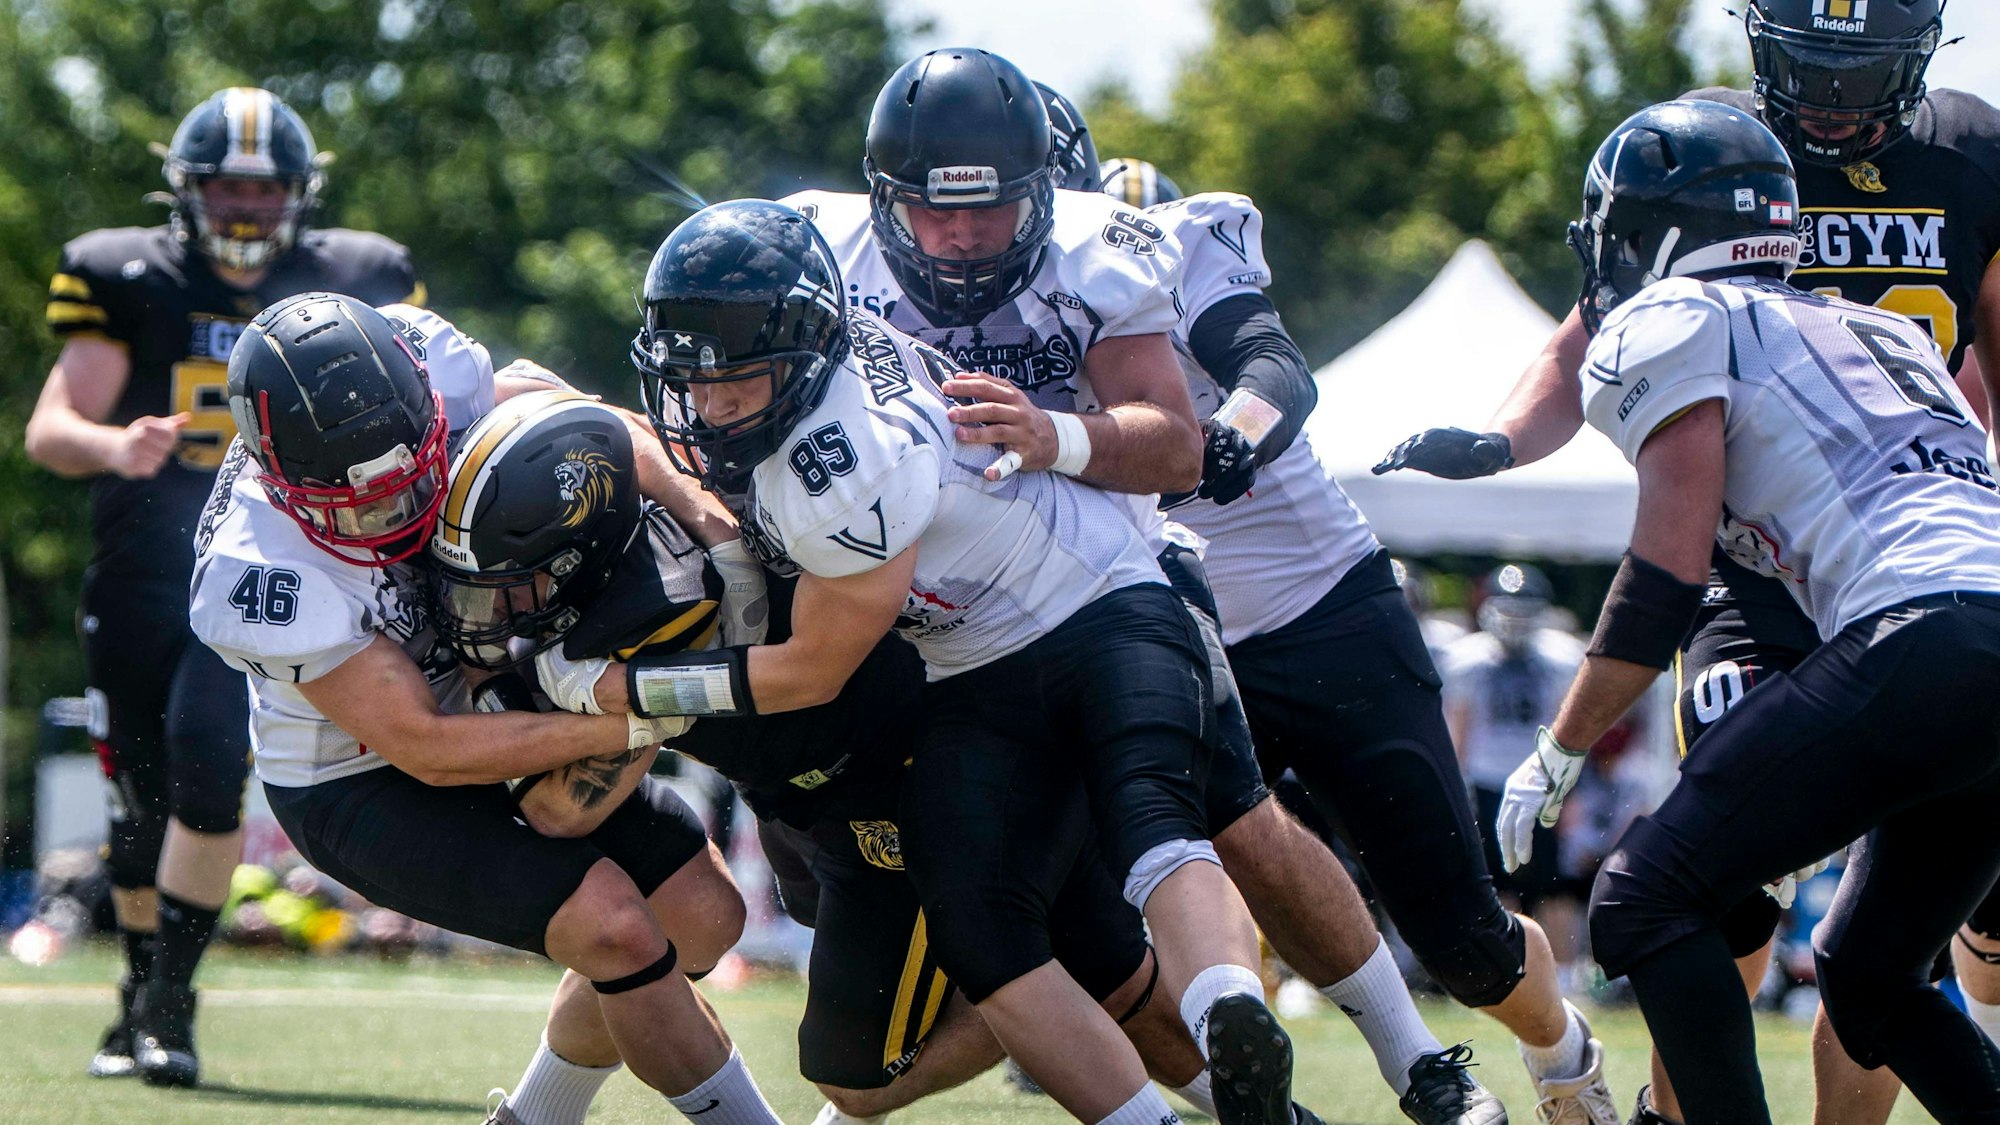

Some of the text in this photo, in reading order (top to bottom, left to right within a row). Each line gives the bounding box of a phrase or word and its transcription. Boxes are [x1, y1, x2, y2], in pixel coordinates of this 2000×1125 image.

[1813, 16, 1865, 33] Riddell
[943, 170, 983, 182] Riddell
[1738, 200, 1752, 208] GFL
[1102, 209, 1167, 257] 36
[1732, 240, 1798, 261] Riddell
[1818, 214, 1946, 268] GYM
[1838, 314, 1970, 428] 6
[788, 421, 859, 496] 85
[434, 538, 467, 562] Riddell
[228, 566, 302, 626] 46
